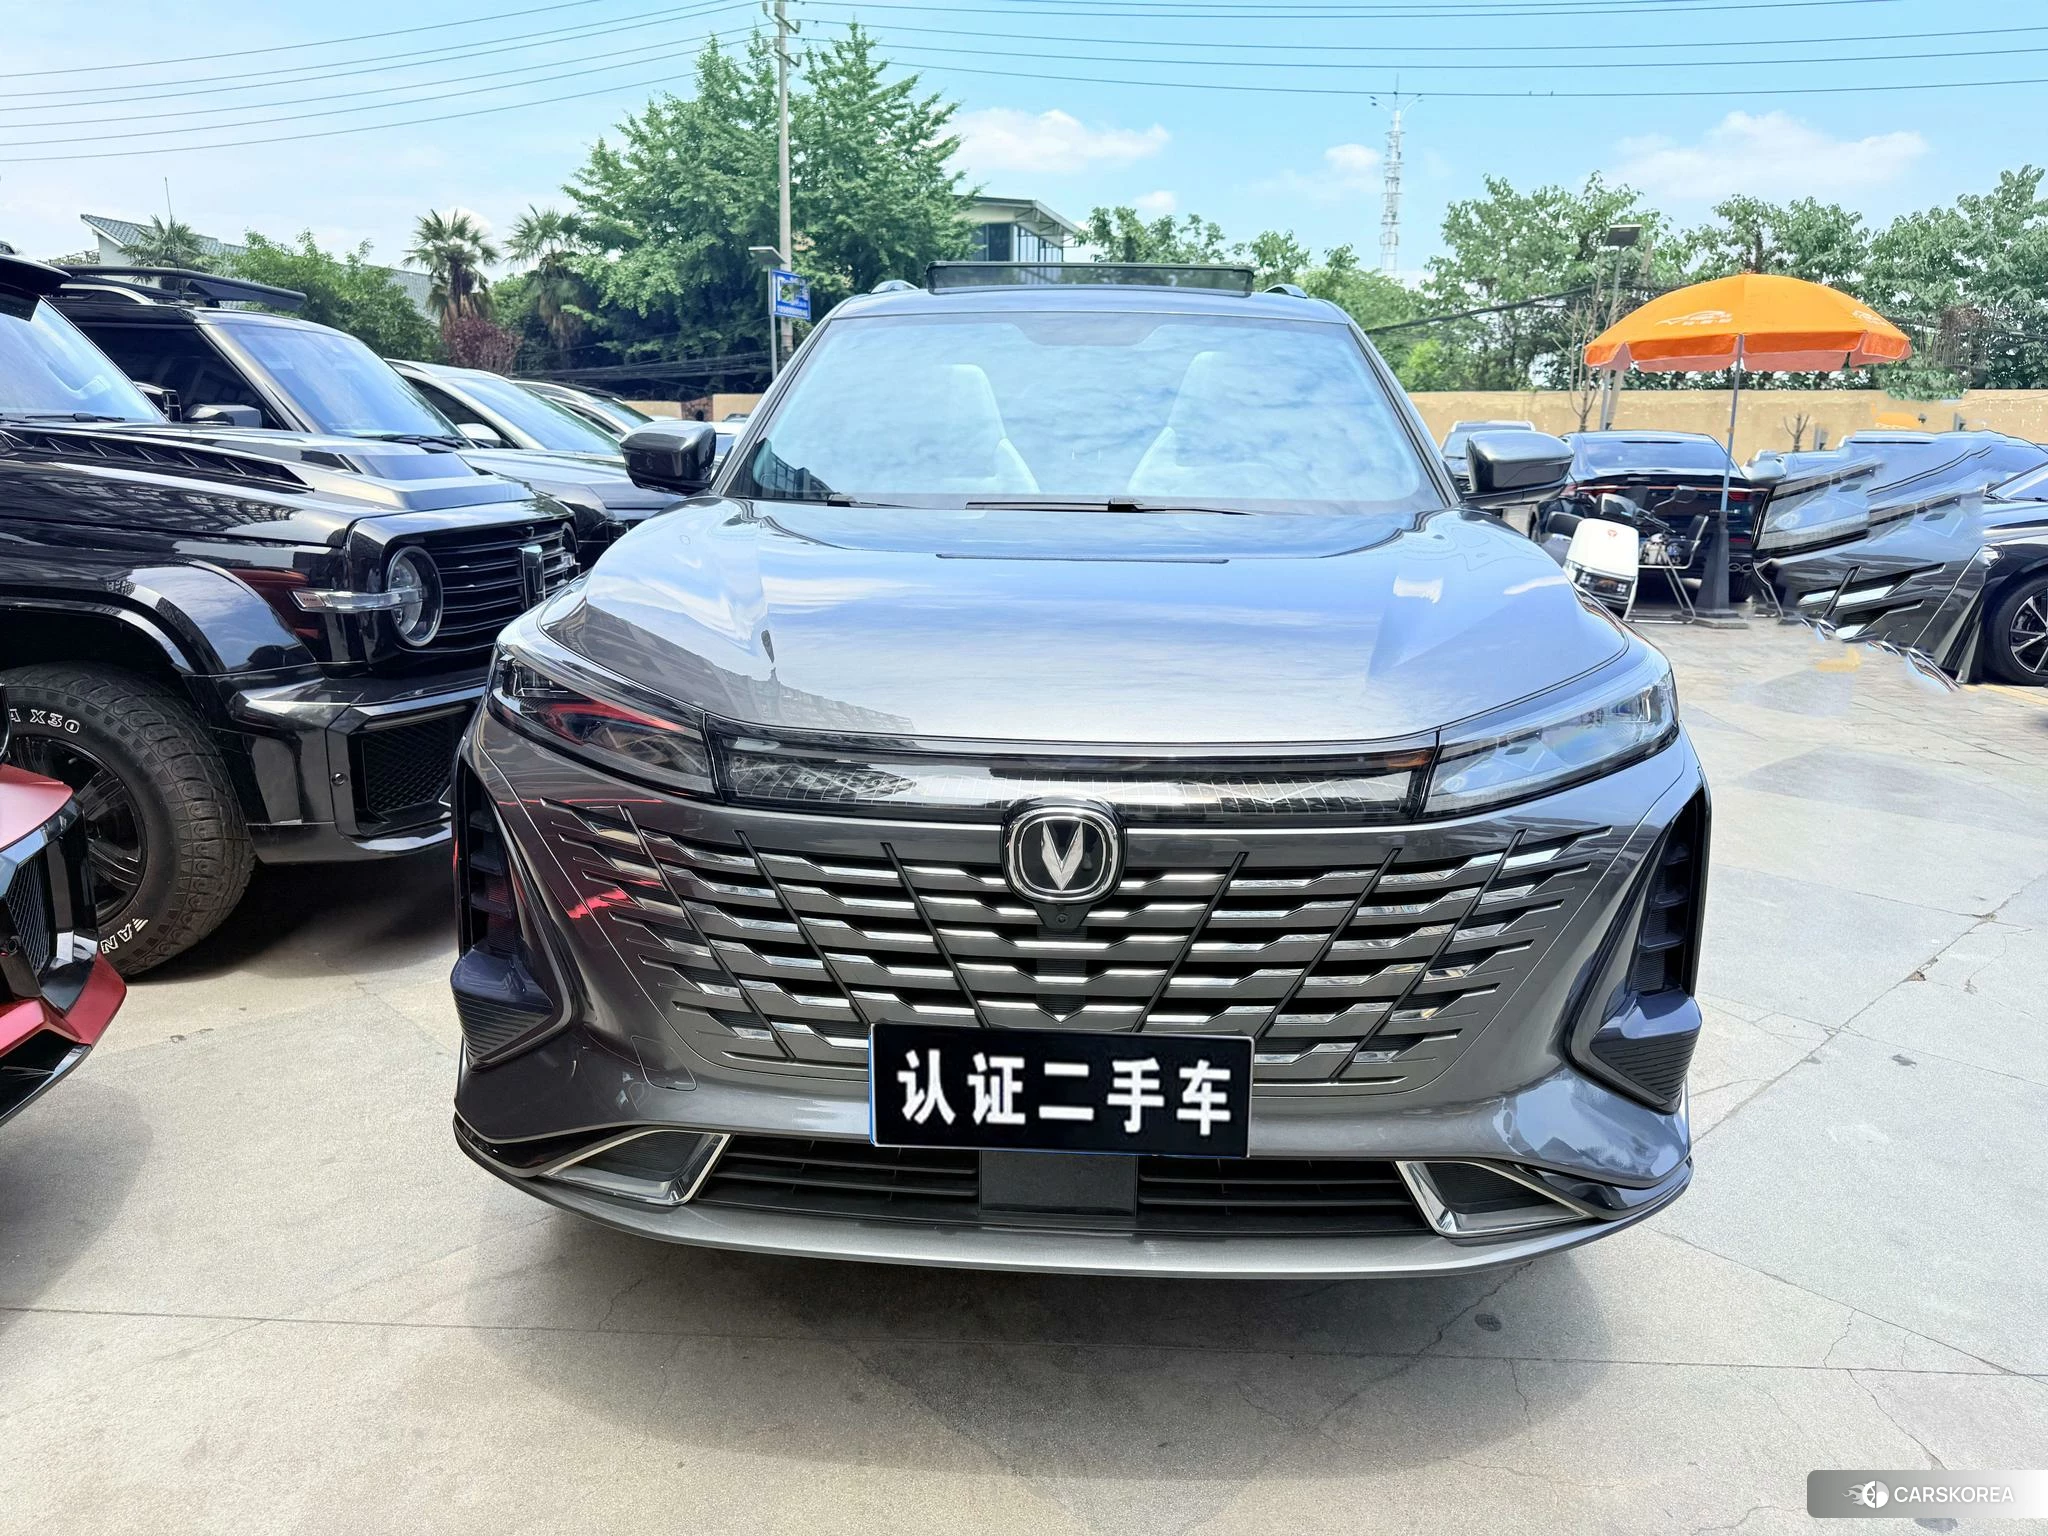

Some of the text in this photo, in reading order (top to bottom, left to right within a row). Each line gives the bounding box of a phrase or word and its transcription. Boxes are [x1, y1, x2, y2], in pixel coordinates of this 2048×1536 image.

[30, 709, 80, 733] X30
[897, 1048, 1232, 1136] 认证二手车
